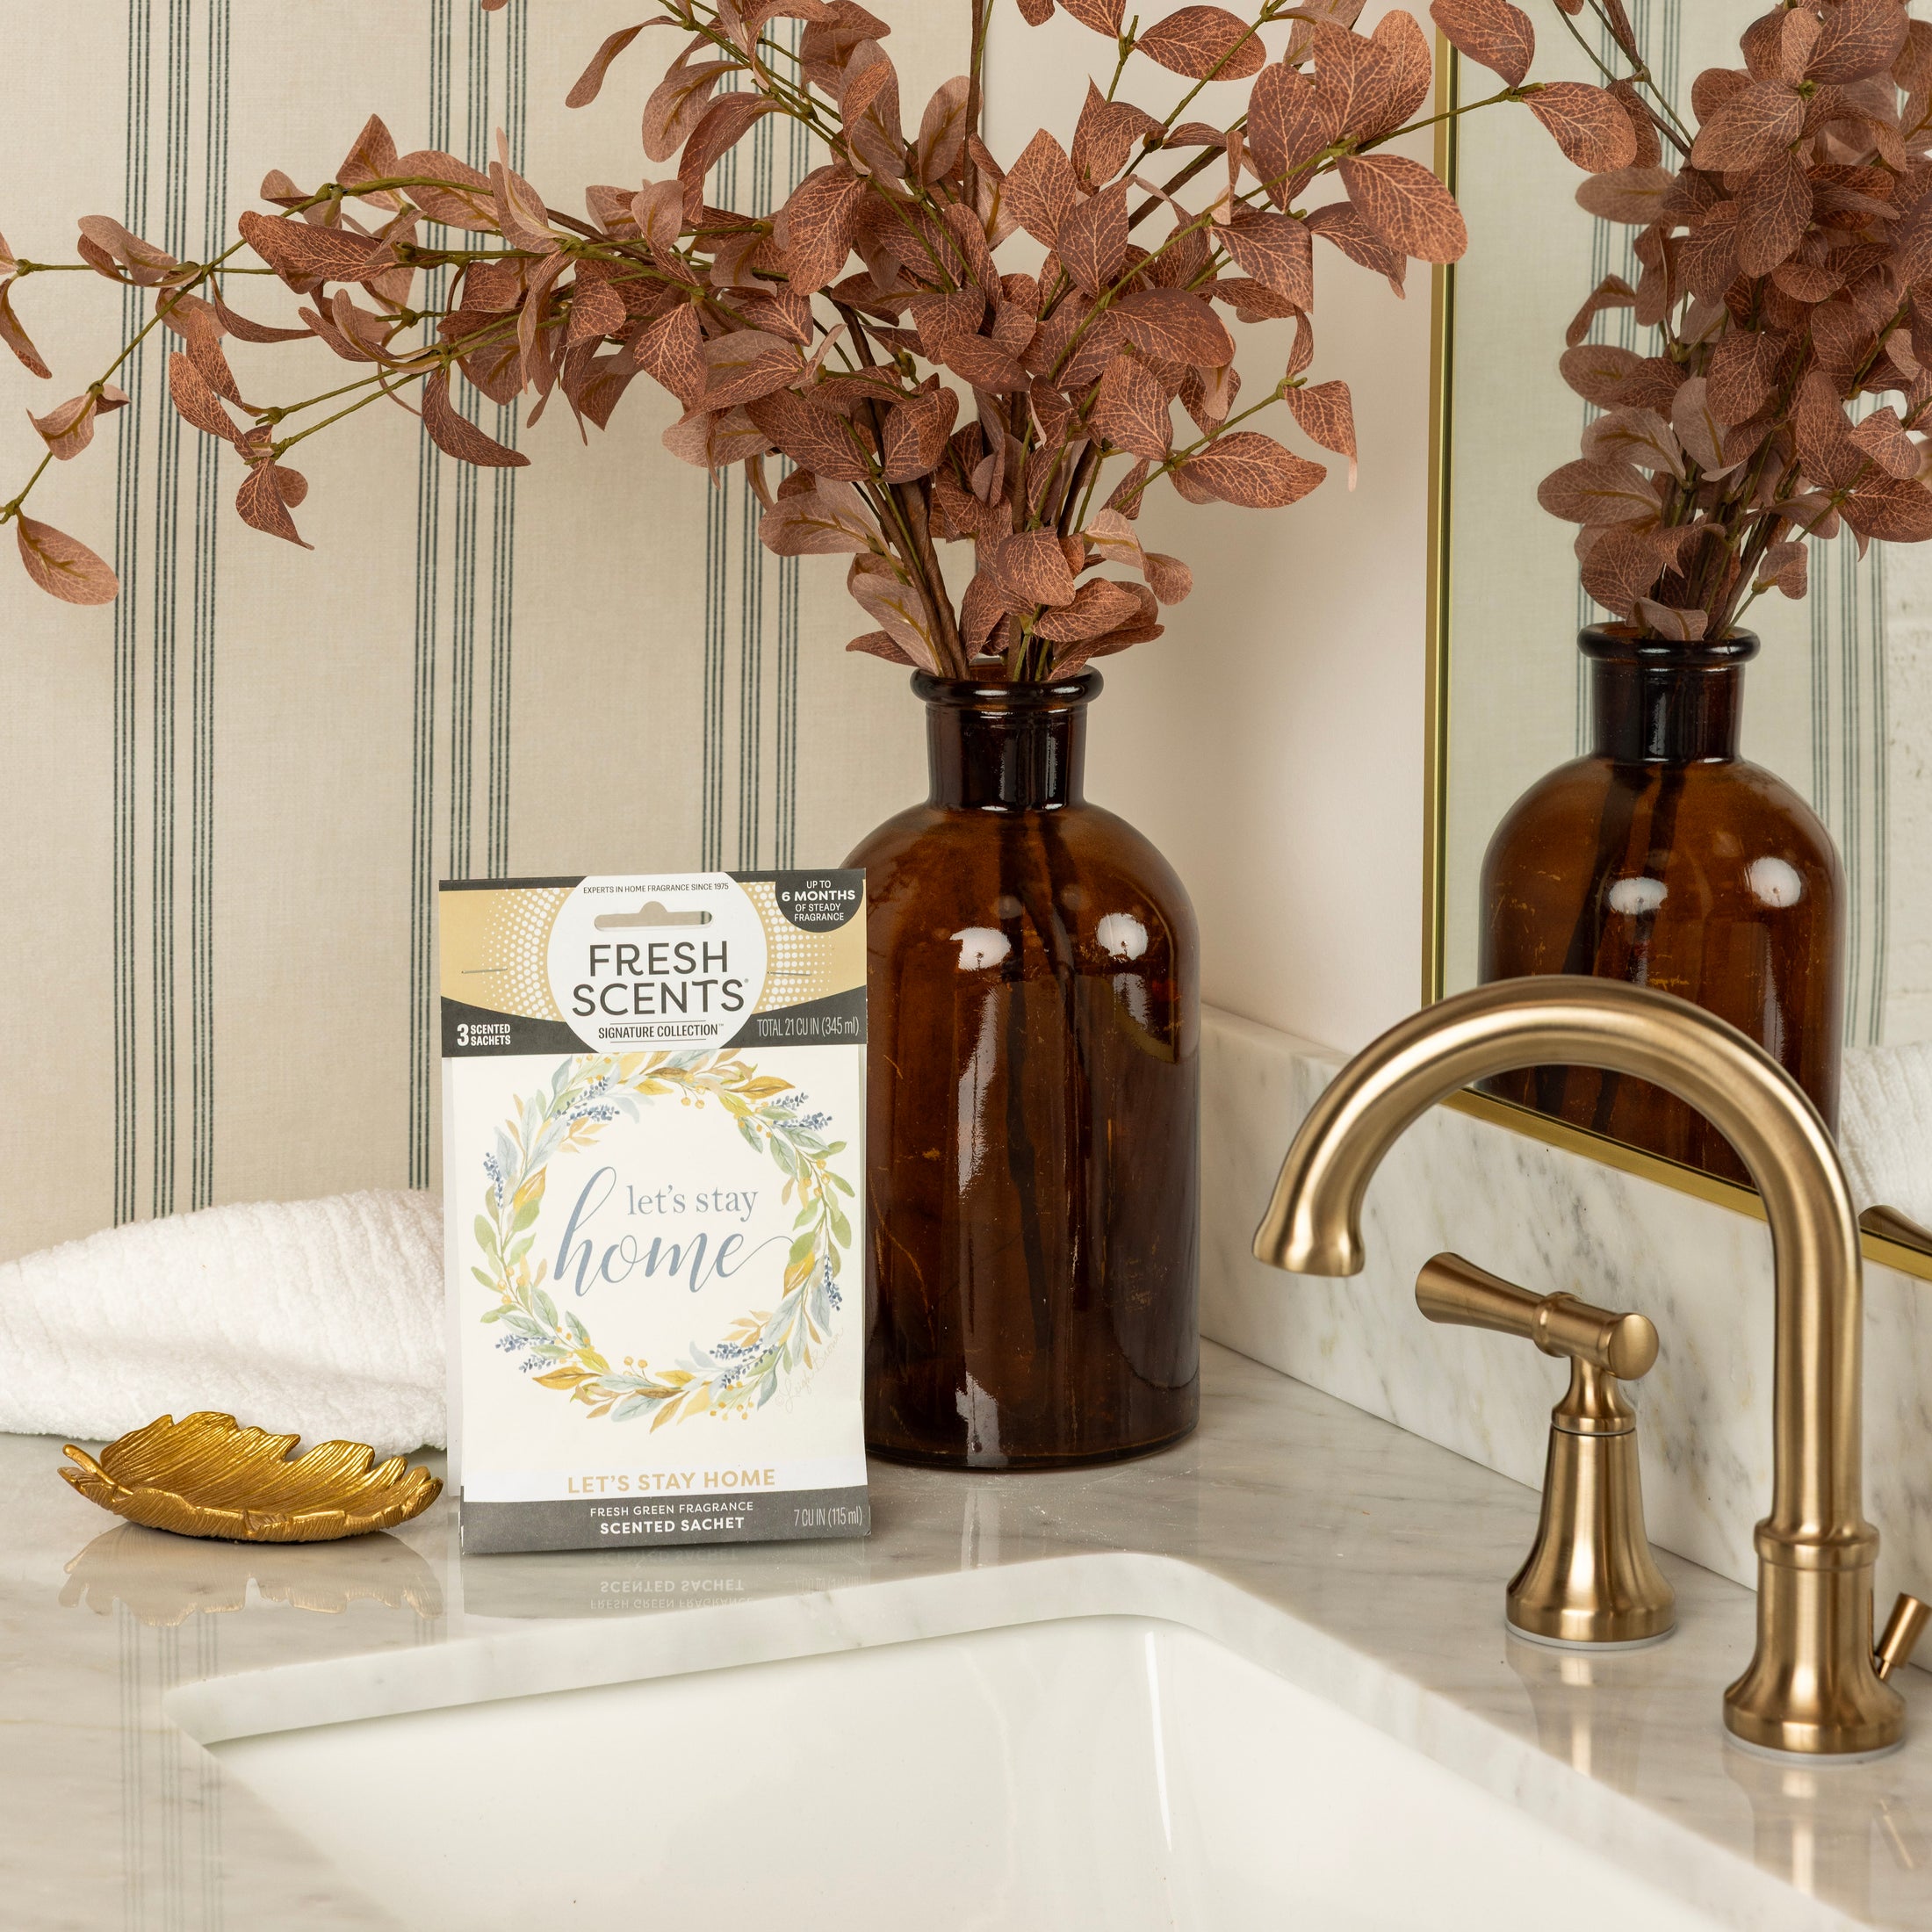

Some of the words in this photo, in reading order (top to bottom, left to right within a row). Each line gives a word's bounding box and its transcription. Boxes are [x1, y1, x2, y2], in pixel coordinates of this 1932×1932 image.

[647, 883, 689, 892] FRAGRANCE
[806, 880, 818, 889] UP
[819, 880, 832, 889] TO
[781, 891, 791, 902] 6
[794, 890, 856, 902] MONTHS
[795, 904, 806, 912] OF
[808, 903, 841, 912] STEADY
[794, 912, 845, 922] FRAGRANCE
[589, 941, 728, 977] FRESH
[572, 978, 745, 1017] SCENTS
[470, 1023, 511, 1034] SCENTED
[598, 1025, 655, 1039] SIGNATURE
[757, 1018, 783, 1037] TOTAL
[785, 1018, 795, 1036] 21
[796, 1017, 808, 1035] CU
[810, 1017, 819, 1035] IN
[821, 1016, 843, 1037] (345
[844, 1015, 860, 1036] ml)
[457, 1023, 469, 1047] 3
[470, 1034, 511, 1046] SACHETS
[626, 1185, 686, 1215] let's
[696, 1186, 759, 1222] stay
[553, 1166, 795, 1297] home
[567, 1474, 630, 1494] LET'S
[638, 1472, 696, 1491] STAY
[703, 1468, 775, 1489] HOME
[590, 1504, 630, 1517] FRESH
[633, 1503, 674, 1517] GREEN
[679, 1502, 754, 1514] FRAGRANCE
[793, 1509, 801, 1527] 7
[801, 1508, 814, 1527] CU
[816, 1507, 825, 1526] IN
[827, 1506, 847, 1528] (115
[847, 1505, 863, 1526] ml)
[600, 1519, 676, 1535] SCENTED
[681, 1517, 745, 1532] SACHET
